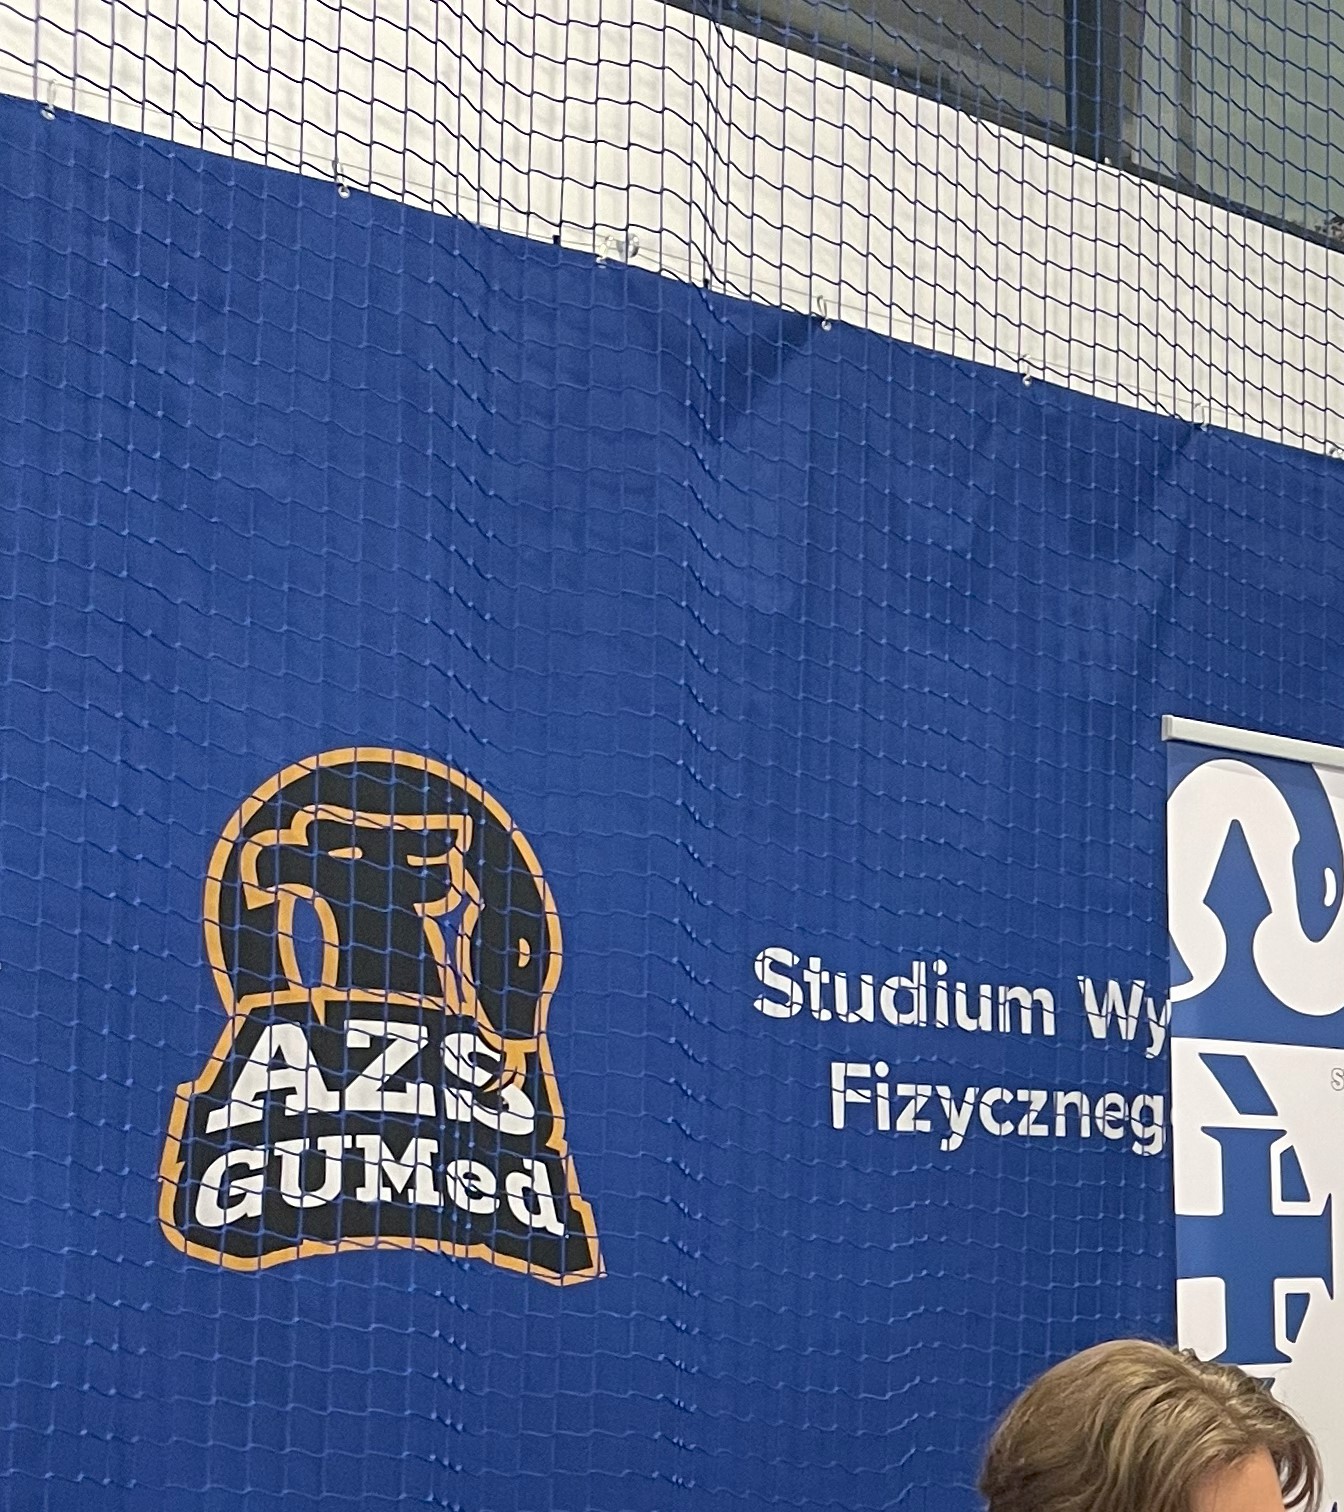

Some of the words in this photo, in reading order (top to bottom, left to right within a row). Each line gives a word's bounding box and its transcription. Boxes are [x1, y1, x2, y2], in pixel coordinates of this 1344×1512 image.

[753, 946, 1055, 1036] Studium
[1078, 975, 1172, 1058] Wy
[204, 1018, 535, 1135] AZS
[830, 1061, 1166, 1156] Fizyczneg
[194, 1134, 568, 1237] GUMed
